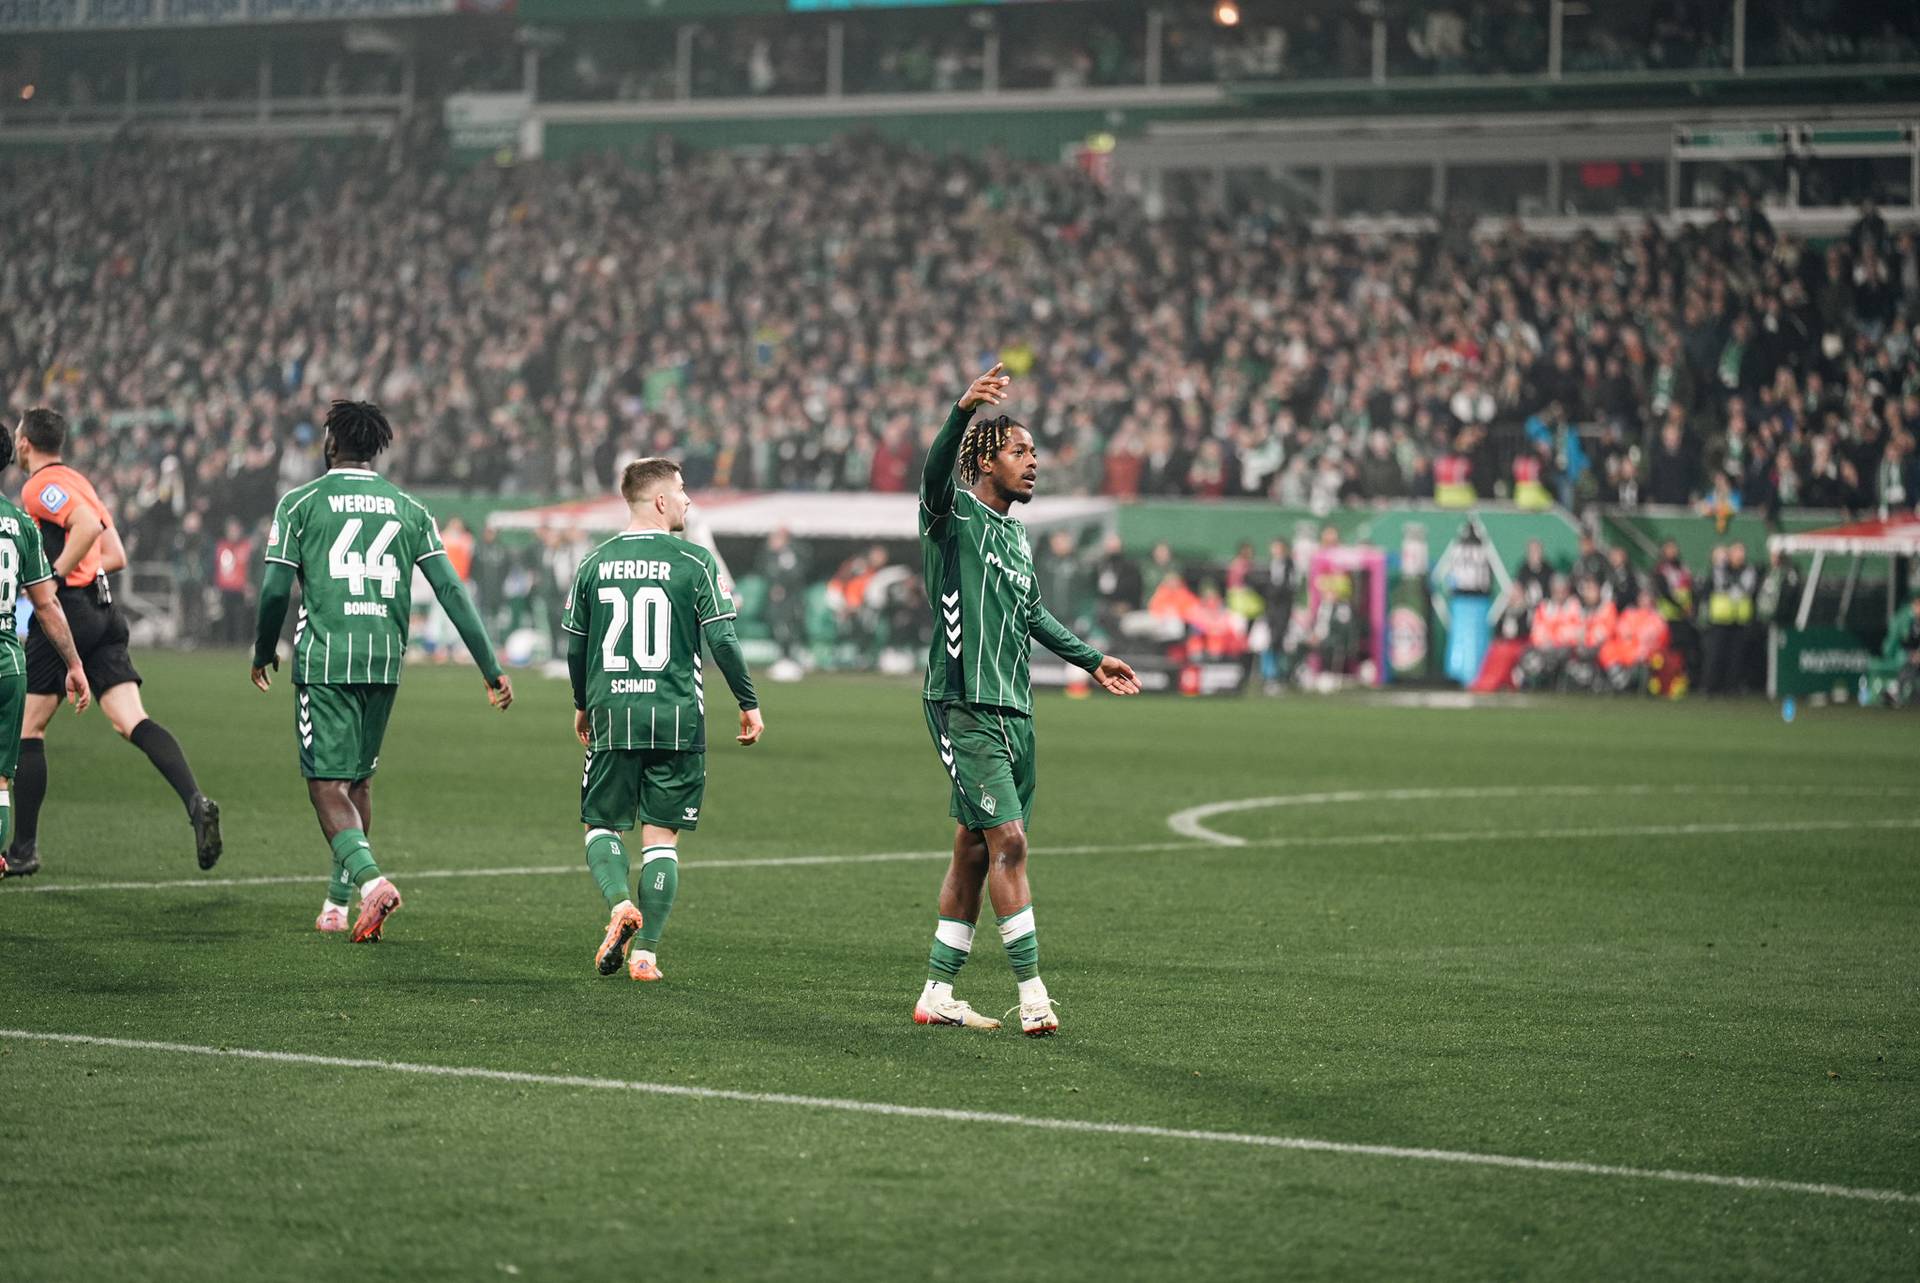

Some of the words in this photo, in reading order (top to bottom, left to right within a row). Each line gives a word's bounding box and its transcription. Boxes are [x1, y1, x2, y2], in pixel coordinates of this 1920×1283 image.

[328, 494, 397, 516] WERDER
[328, 518, 402, 599] 44
[598, 559, 672, 581] WERDER
[597, 586, 672, 672] 20
[610, 678, 657, 693] SCHMID
